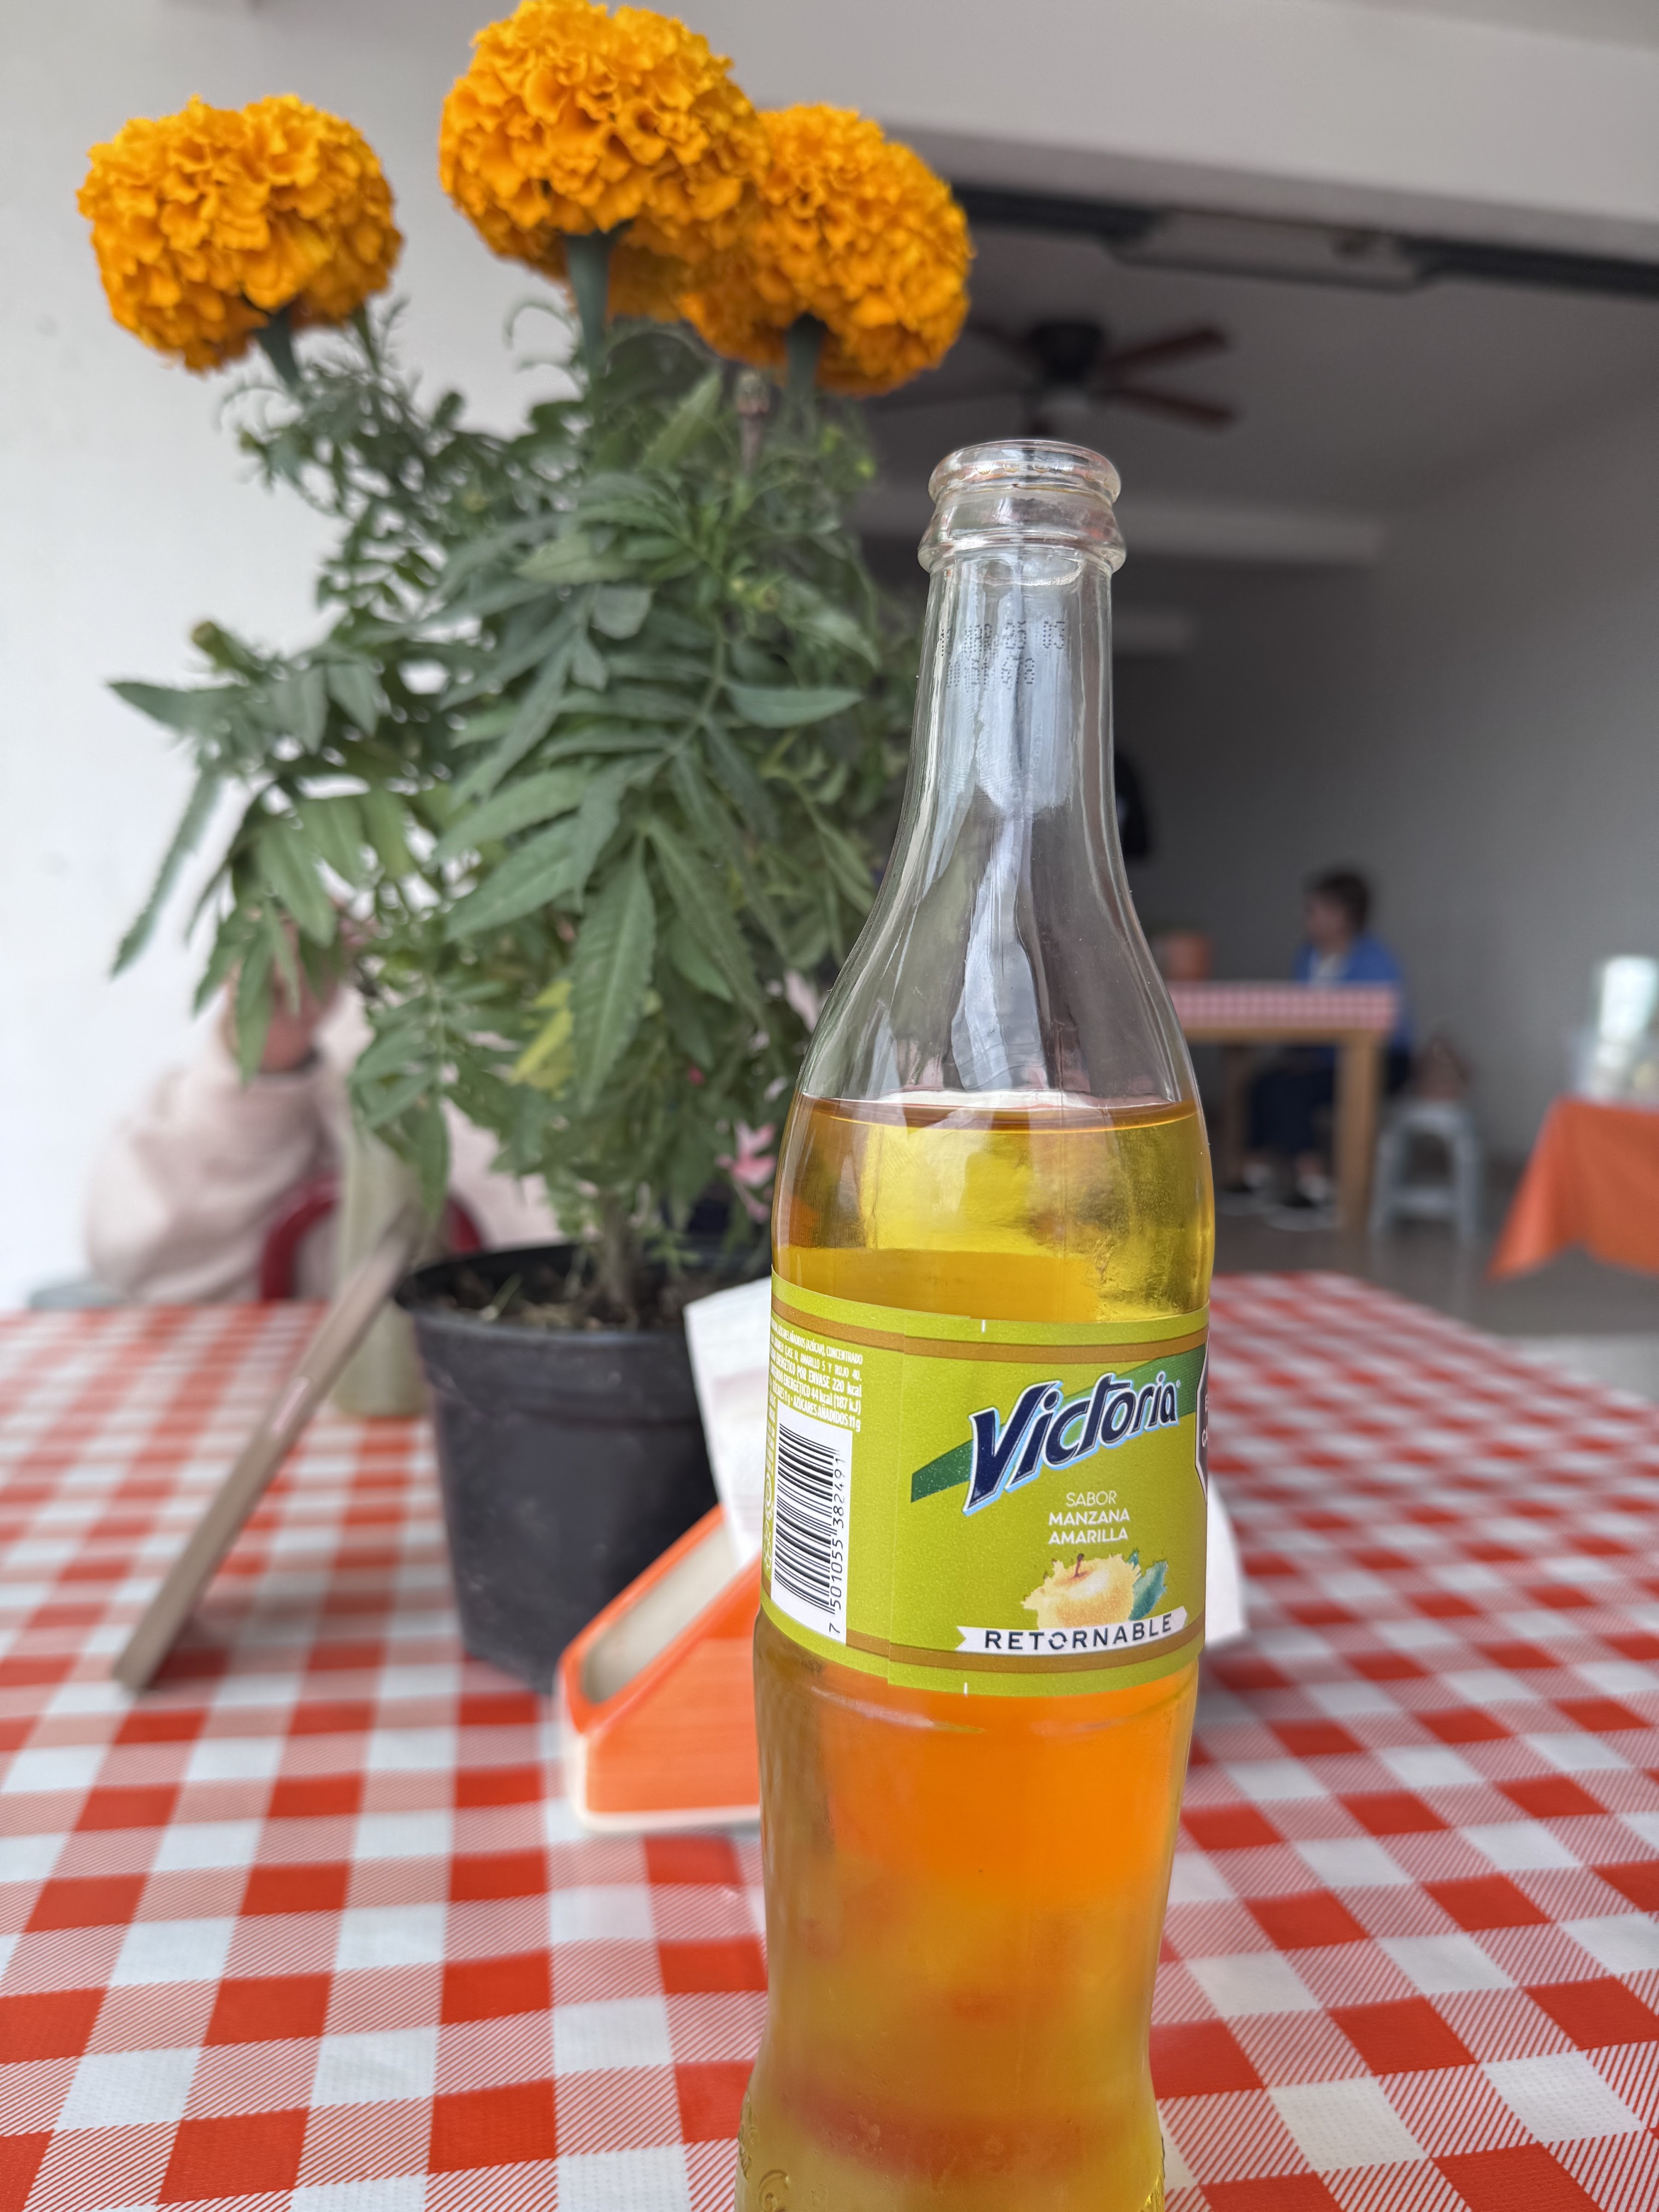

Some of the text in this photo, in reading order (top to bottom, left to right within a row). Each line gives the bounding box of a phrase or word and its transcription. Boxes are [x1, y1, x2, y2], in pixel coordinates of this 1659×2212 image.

[800, 1353, 820, 1370] AMARILLO
[822, 1360, 825, 1371] 5
[828, 1362, 832, 1373] Y
[835, 1365, 849, 1377] ROJO
[826, 1346, 863, 1365] CONCENTRADO
[783, 1373, 811, 1398] ENERGÉTICO
[811, 1387, 818, 1401] 44
[819, 1388, 832, 1406] kcal
[834, 1393, 848, 1410] (187
[797, 1365, 806, 1381] POR
[808, 1370, 830, 1389] ENVASE
[832, 1377, 845, 1393] 220
[847, 1382, 862, 1397] kcal
[793, 1394, 818, 1417] AZÚCARES
[817, 1404, 849, 1426] AÑADIDOS
[855, 1419, 861, 1432] g
[962, 1371, 1179, 1517] Victoria
[1065, 1490, 1118, 1507] SABOR
[1048, 1507, 1131, 1526] MANZANA
[1047, 1526, 1129, 1545] AMARILLA
[984, 1612, 1172, 1650] RETORNABLE
